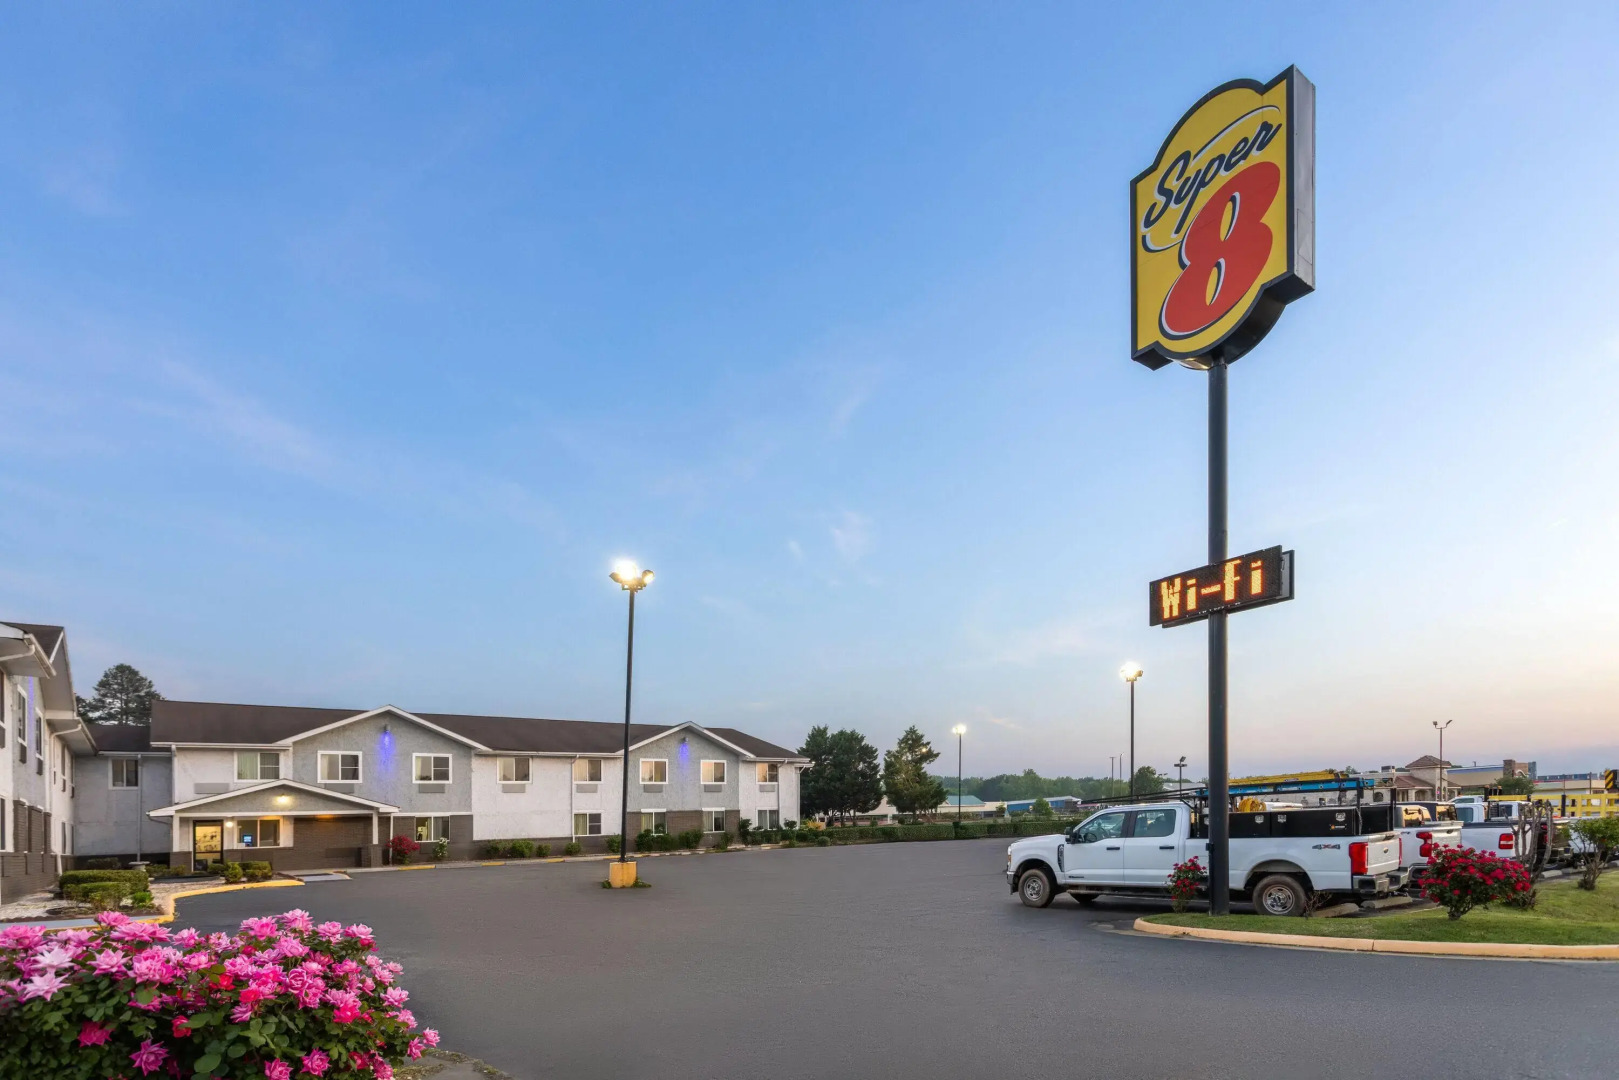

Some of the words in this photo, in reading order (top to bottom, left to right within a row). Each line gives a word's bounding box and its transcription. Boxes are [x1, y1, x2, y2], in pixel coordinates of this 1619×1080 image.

[1141, 120, 1283, 237] Super
[1158, 161, 1281, 341] 8
[1160, 559, 1263, 620] Wi-Fi
